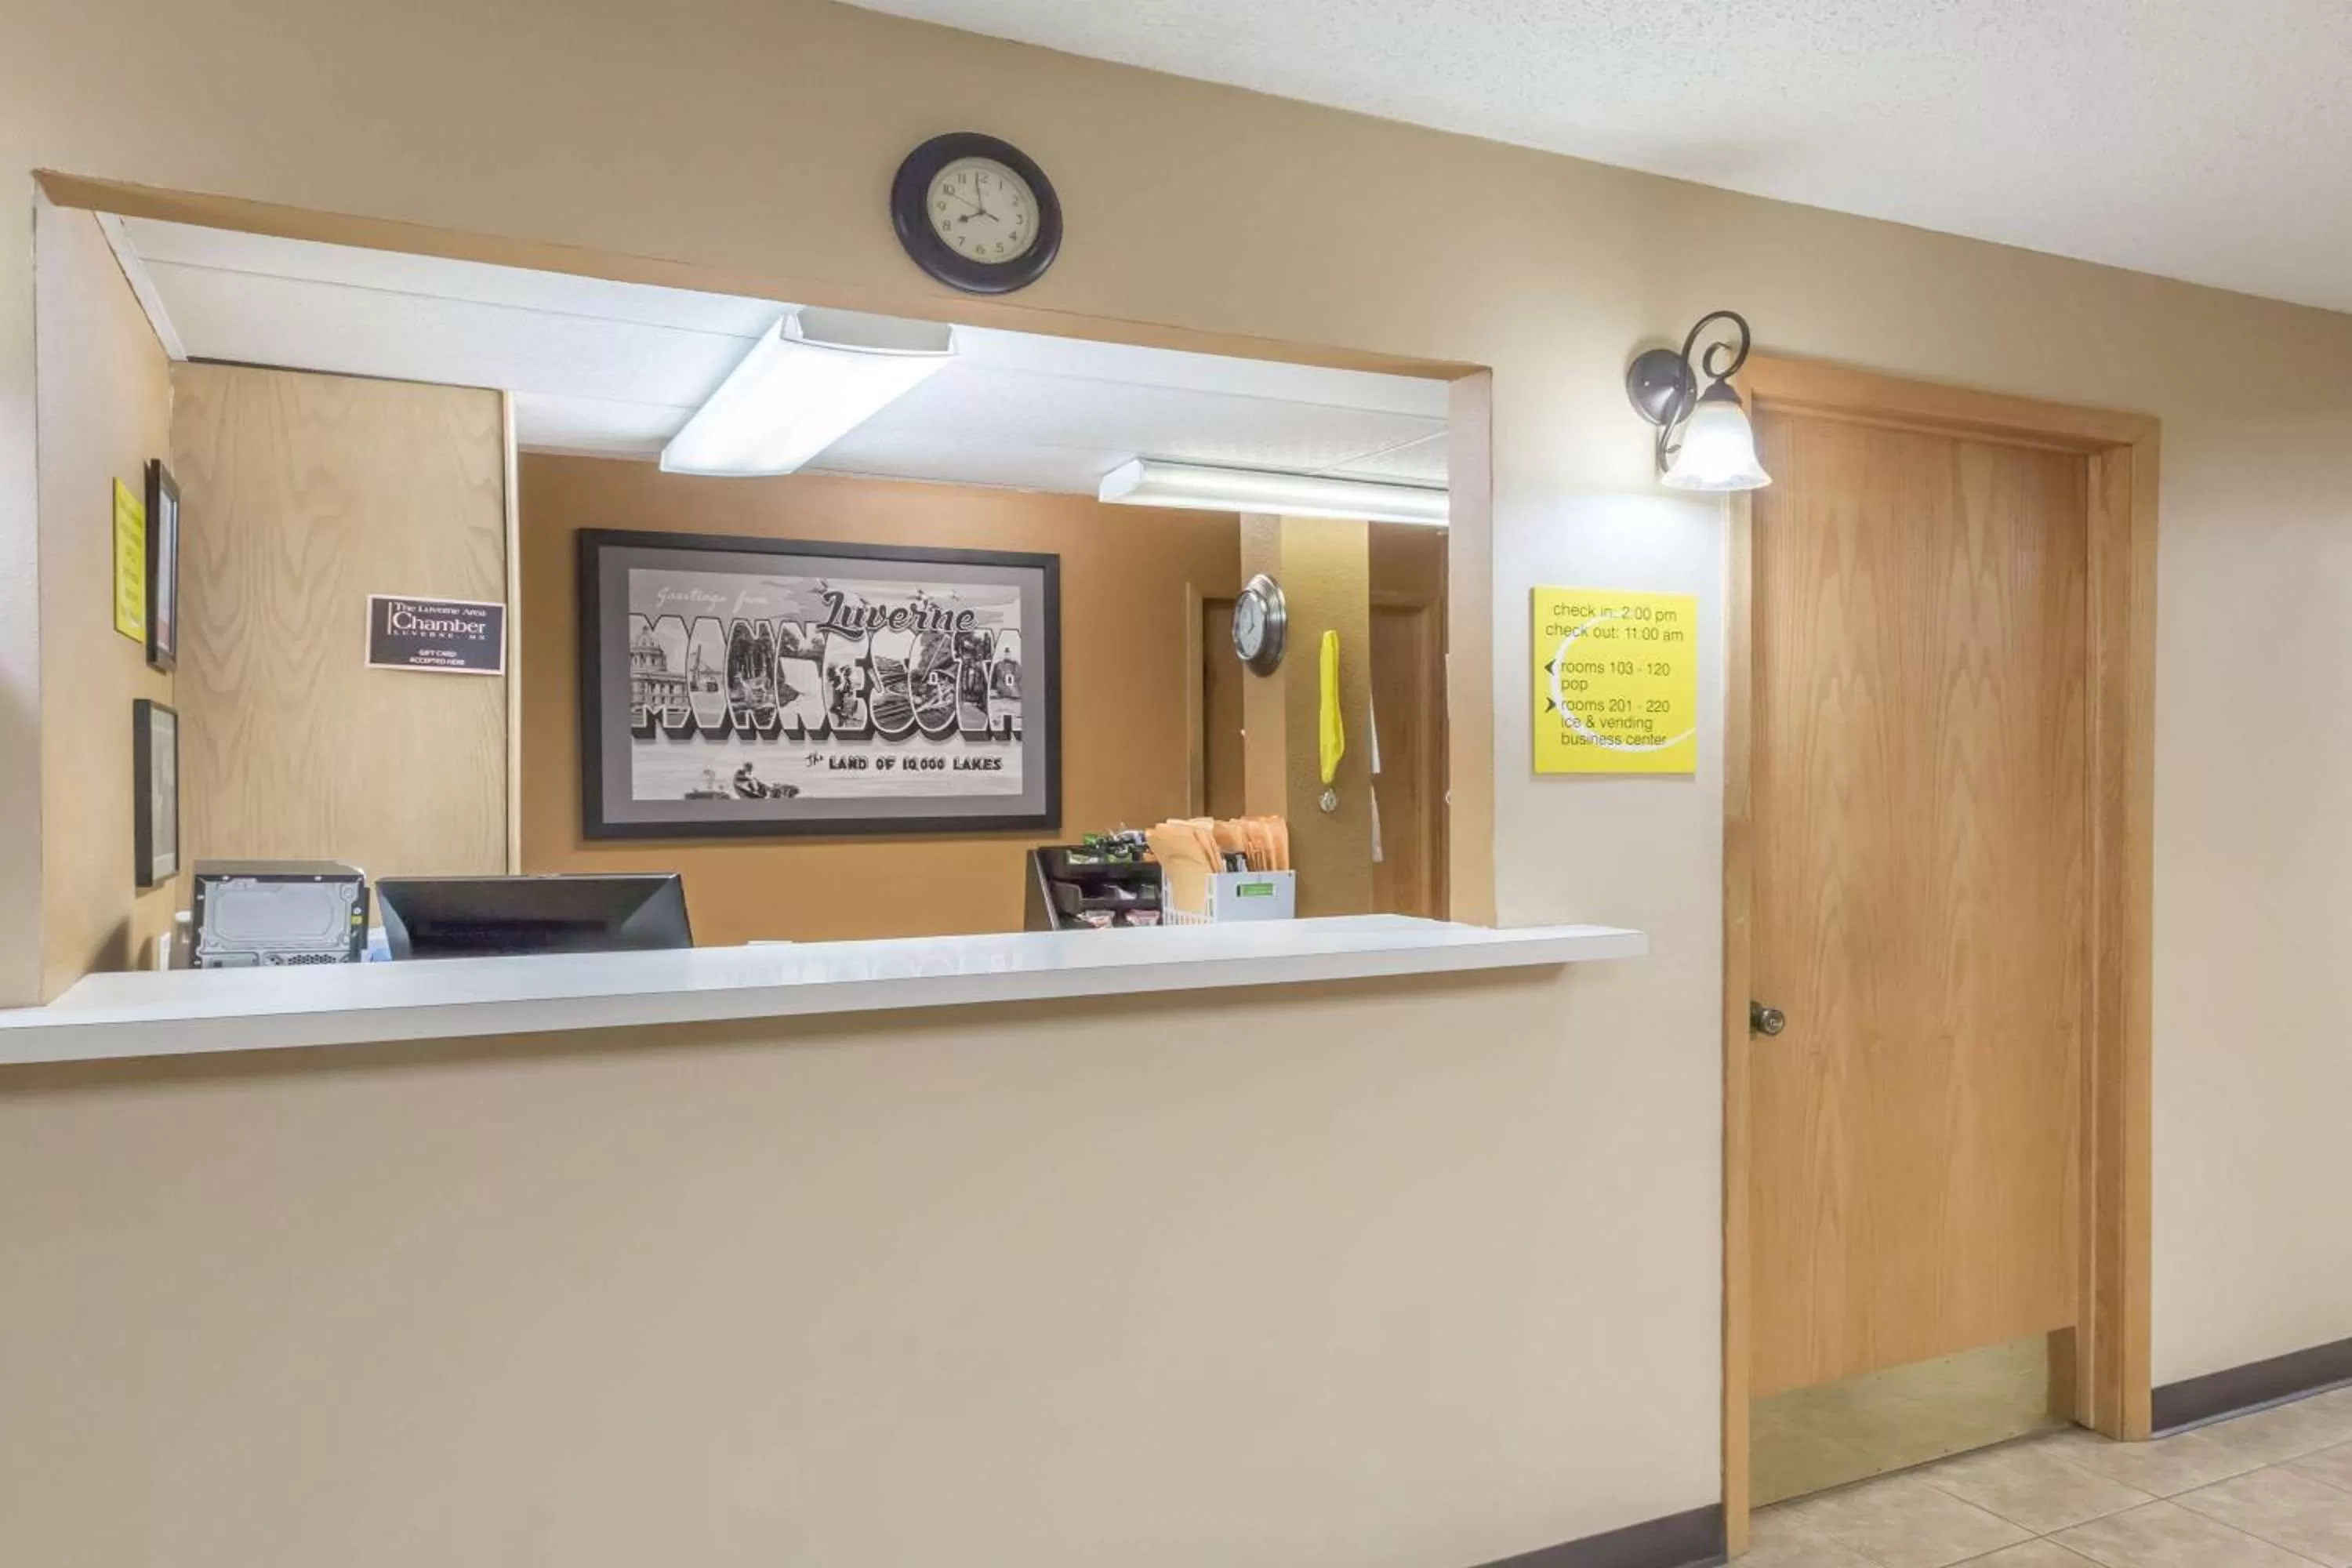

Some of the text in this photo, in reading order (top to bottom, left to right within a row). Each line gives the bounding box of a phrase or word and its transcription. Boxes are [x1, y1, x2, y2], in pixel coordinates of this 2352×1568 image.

[957, 173, 967, 184] 11
[957, 236, 967, 248] 7
[815, 591, 978, 639] Luverne
[1553, 602, 1595, 617] check
[1655, 610, 1678, 624] pm
[393, 611, 487, 633] Chamber
[1545, 622, 1588, 637] check
[1663, 630, 1684, 641] am
[1561, 662, 1605, 674] rooms
[1610, 661, 1634, 676] 103
[1647, 662, 1671, 677] 120
[629, 614, 1022, 743] MINNESOTA
[1561, 679, 1589, 692] pop
[1561, 699, 1605, 712] rooms
[1609, 699, 1632, 713] 201
[1646, 699, 1671, 713] 220
[1561, 715, 1653, 732] ice & vending
[1561, 731, 1668, 746] business center
[828, 756, 869, 770] LAND
[875, 757, 896, 770] OF
[953, 757, 1003, 771] LAKES
